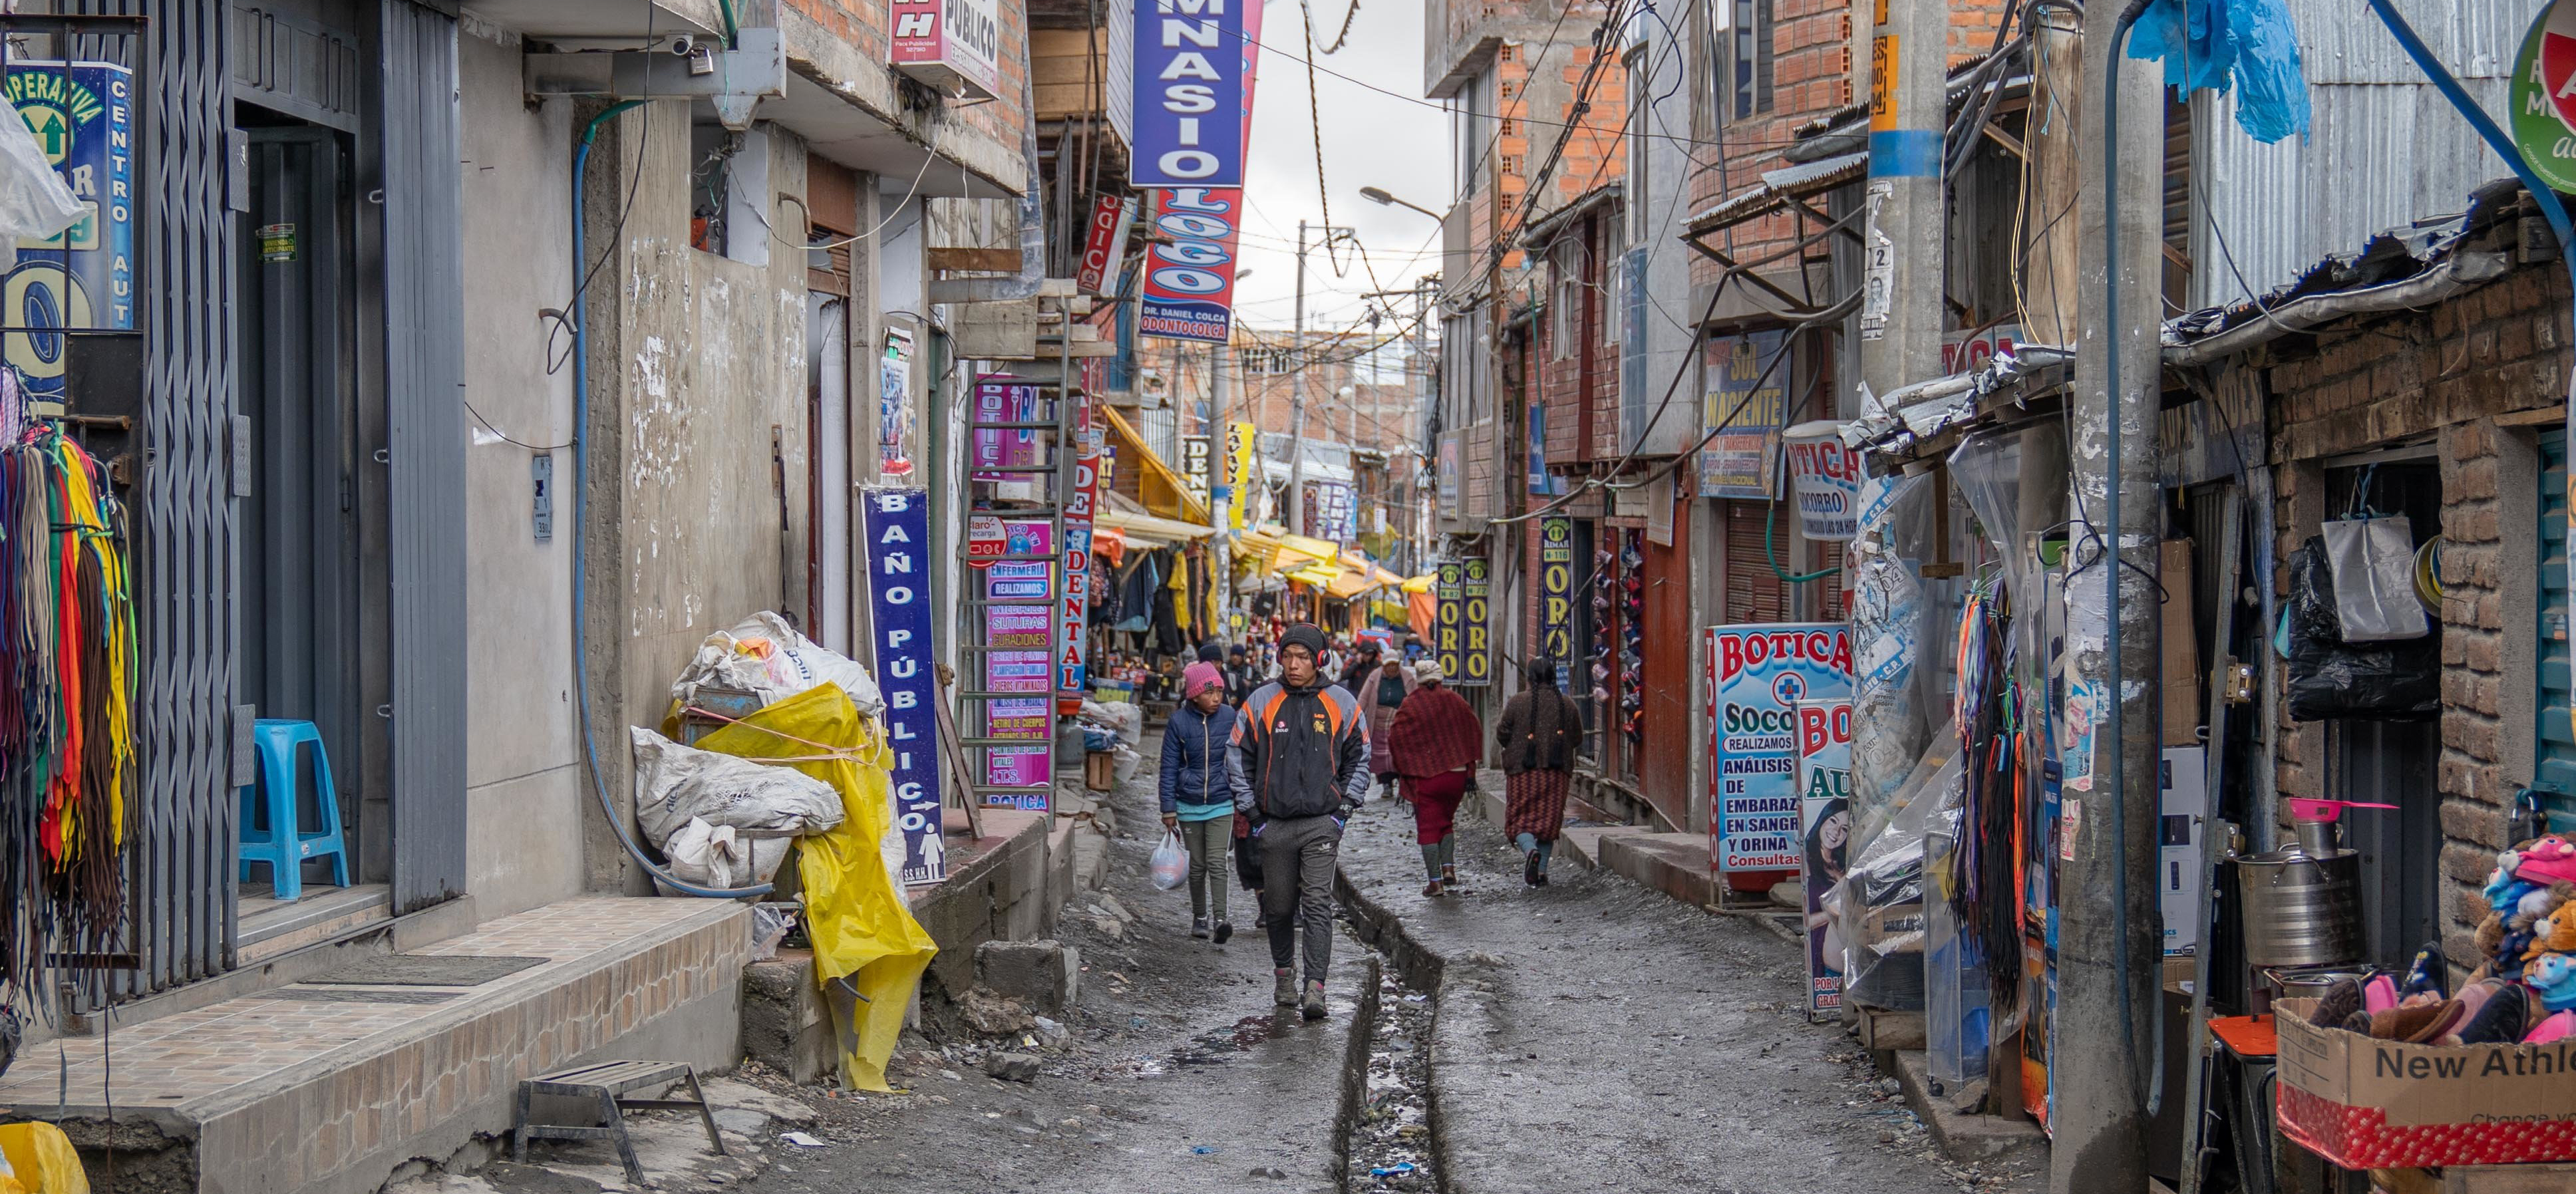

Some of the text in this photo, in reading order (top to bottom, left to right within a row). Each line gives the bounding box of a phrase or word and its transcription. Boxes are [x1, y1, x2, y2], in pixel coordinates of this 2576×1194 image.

[112, 80, 128, 222] CENTRO
[1144, 306, 1225, 323] DR. DANIEL COLCA
[1141, 317, 1226, 339] ODONTOCOLCA
[1707, 341, 1758, 382] GRUPO SOL
[1706, 388, 1781, 428] NACIENTE
[977, 384, 1003, 477] BOTICA
[970, 521, 991, 529] laro
[1836, 519, 1844, 532] 24
[882, 494, 913, 605] BAÑO
[1543, 539, 1569, 549] RIMAR
[991, 565, 1045, 577] ENFERMERIA
[1545, 564, 1569, 658] ORO
[993, 617, 1046, 629] SUTURAS
[1062, 550, 1086, 689] DENTAL
[993, 633, 1046, 646] CURACIONES
[1440, 601, 1459, 677] ORO
[1467, 599, 1488, 677] ORO
[1720, 631, 1853, 683] BOTICA
[994, 679, 1047, 691] SUEROS VITAMINADOS
[888, 629, 926, 831] PÚBLICO
[993, 718, 1046, 728] RETIRO DE CUERPOS
[1706, 637, 1718, 863] TÓPICO
[1730, 737, 1792, 750] REALIZAMOS
[993, 757, 1014, 767] VITALES
[1723, 756, 1793, 774] ANÁLISIS
[993, 770, 1021, 784] I.T.S.
[1726, 780, 1744, 794] DE
[1726, 798, 1797, 814] EMBARAZ
[1726, 819, 1744, 833] EN
[1728, 837, 1788, 853] Y ORINA
[1728, 854, 1800, 866] Consultas
[1814, 976, 1832, 990] POR
[2376, 1048, 2466, 1080] New
